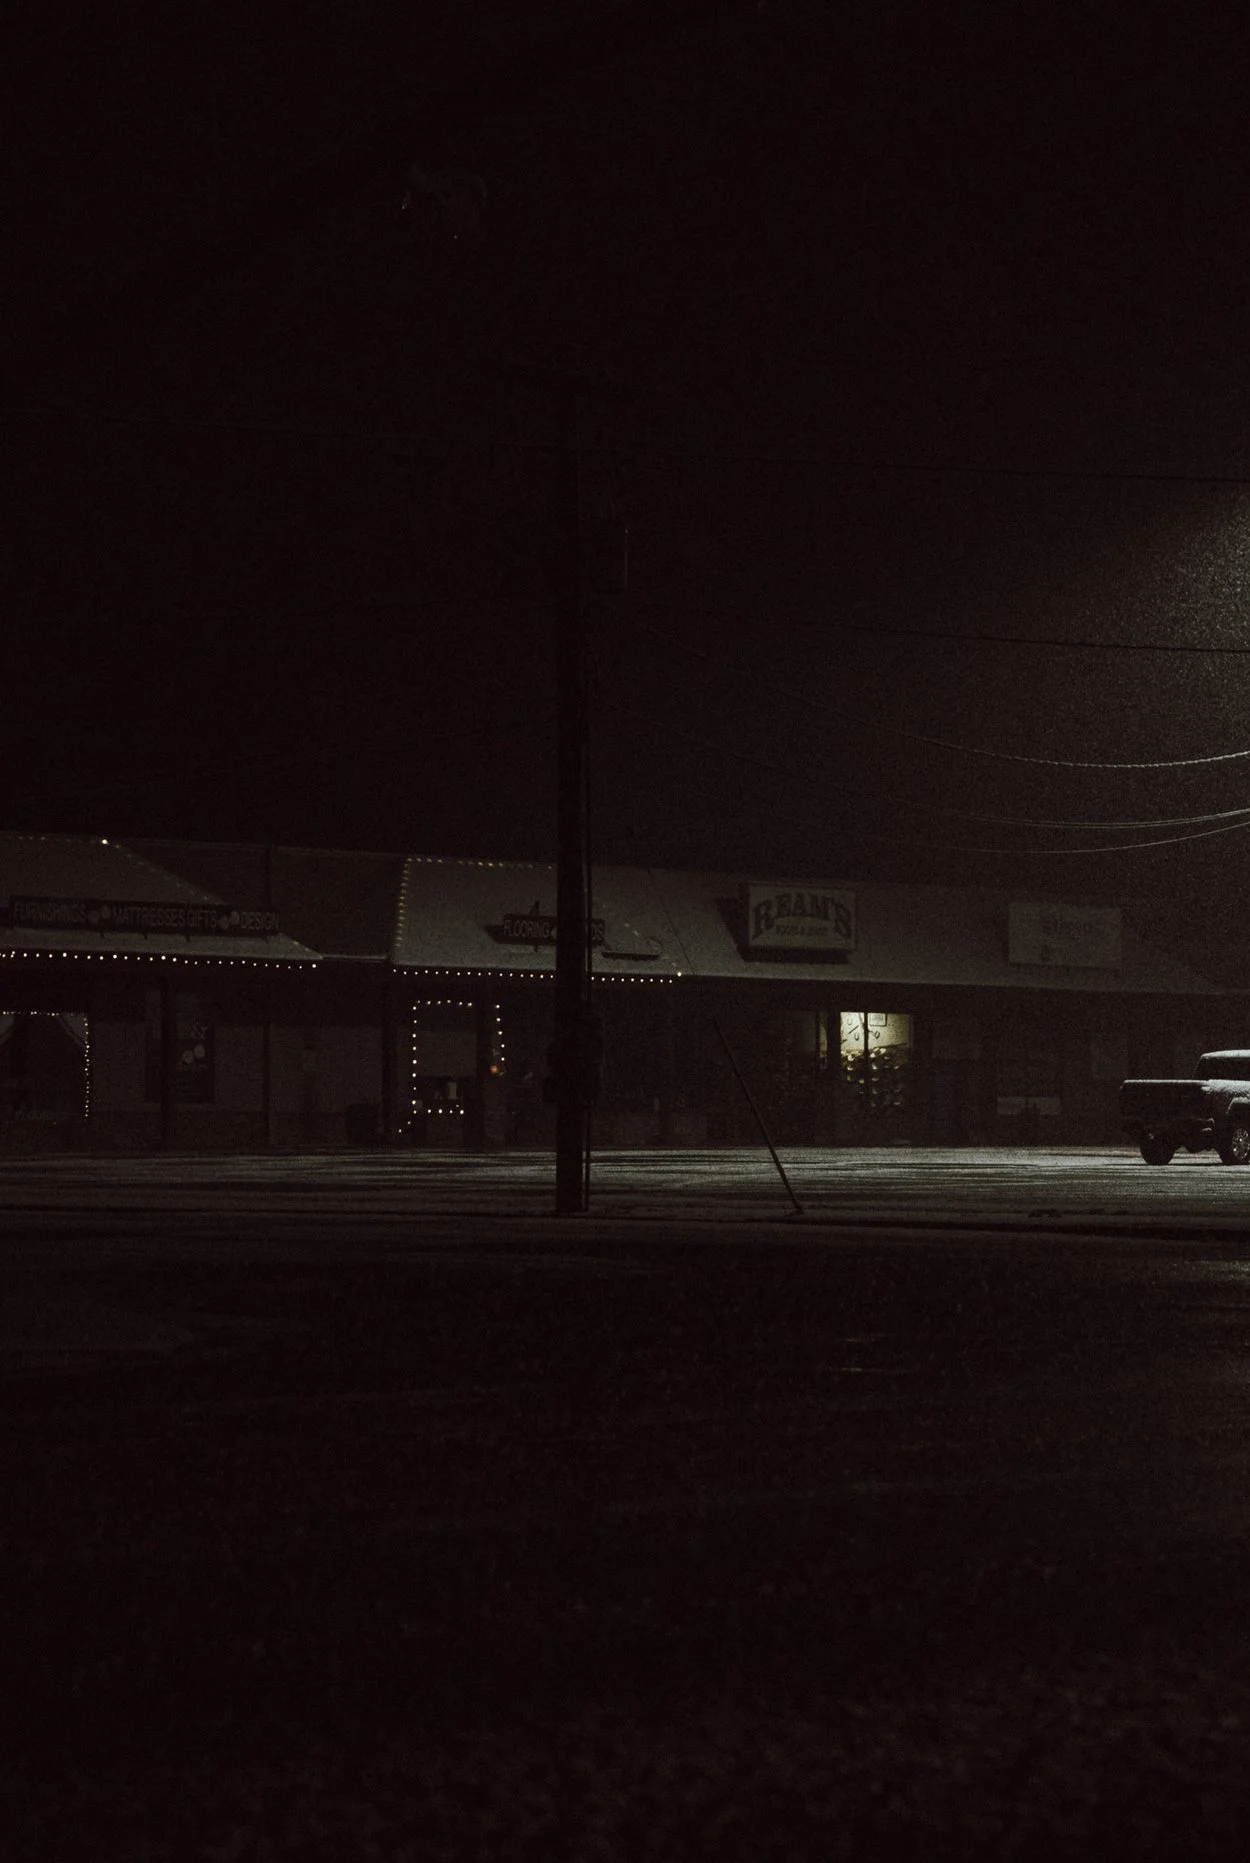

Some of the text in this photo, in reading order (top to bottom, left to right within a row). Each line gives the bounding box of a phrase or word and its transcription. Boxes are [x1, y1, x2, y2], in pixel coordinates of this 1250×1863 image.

[13, 901, 280, 931] FURNISHINGS MATTRESSES GIFTS DESIGN
[503, 919, 550, 939] FLOORING
